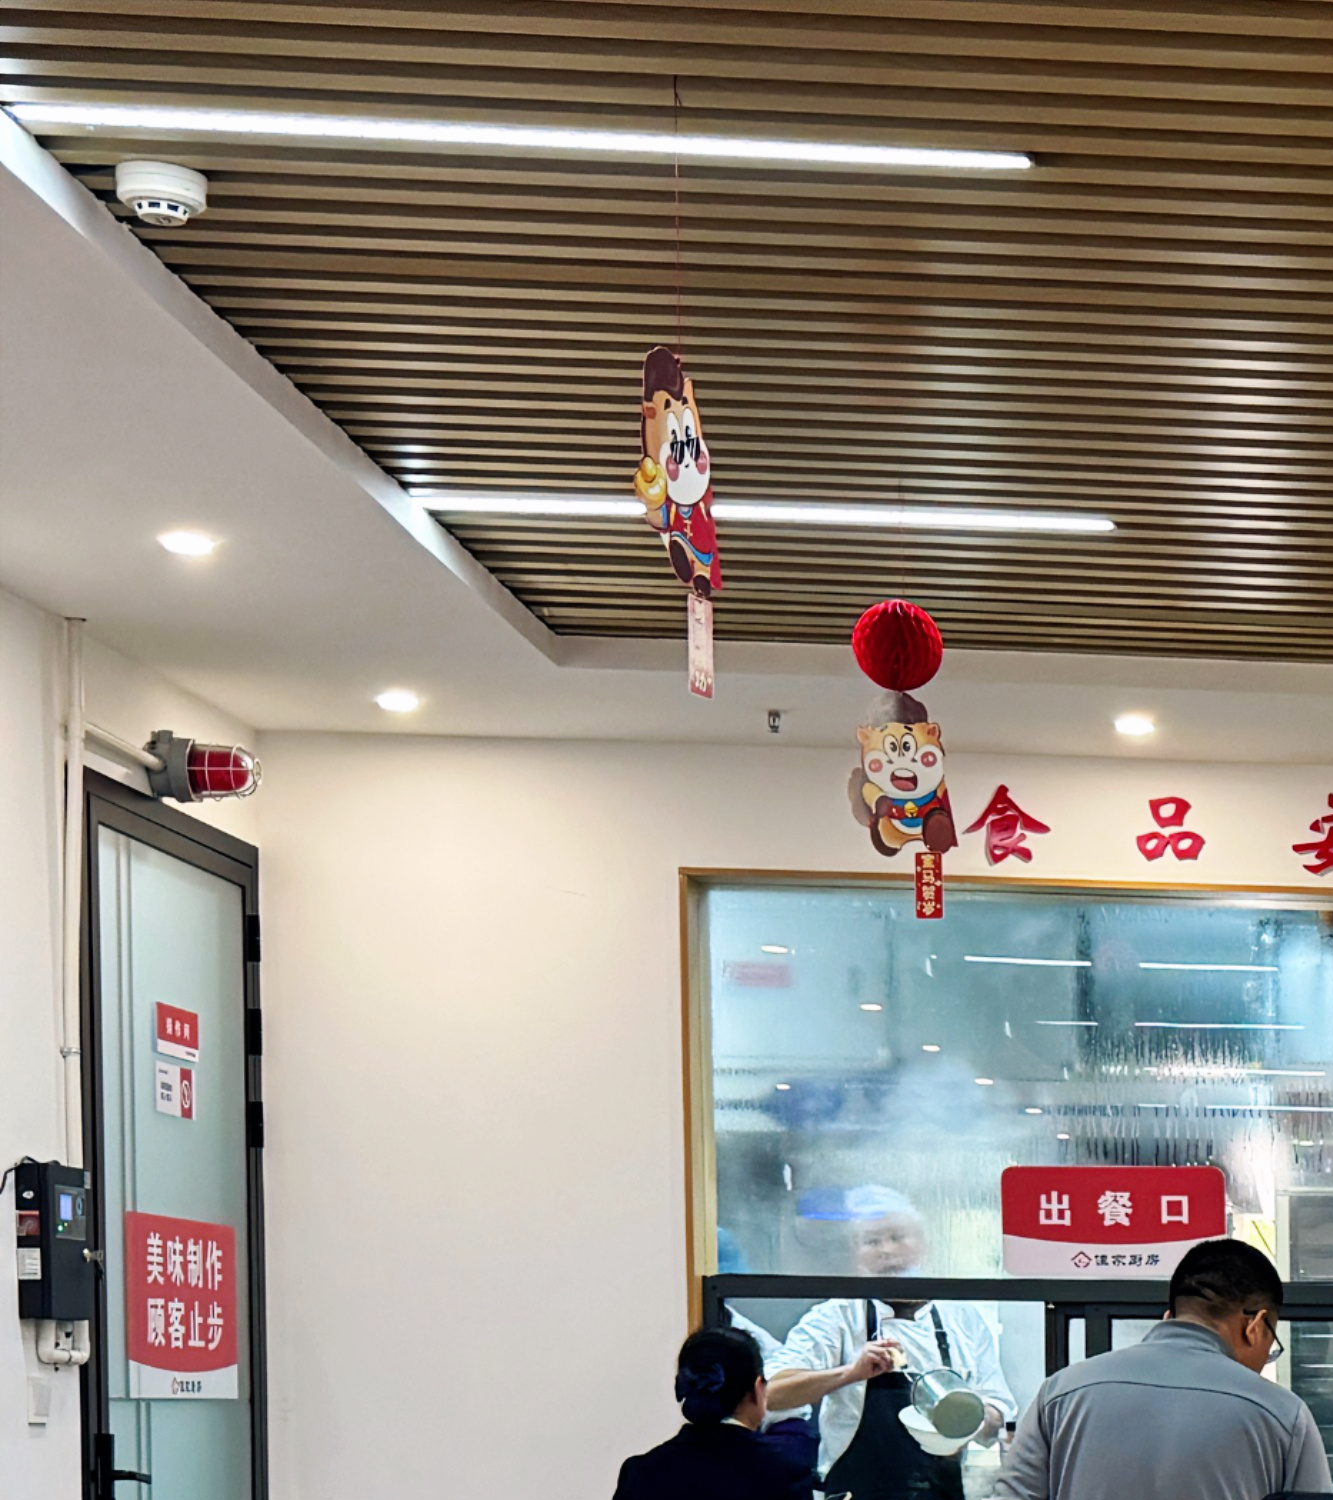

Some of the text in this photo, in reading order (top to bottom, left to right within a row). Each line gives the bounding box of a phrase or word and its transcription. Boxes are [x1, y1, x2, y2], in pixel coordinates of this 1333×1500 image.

[1039, 1191, 1189, 1226] 出餐口
[146, 1232, 222, 1290] 美味制作
[147, 1298, 224, 1350] 顾客止步
